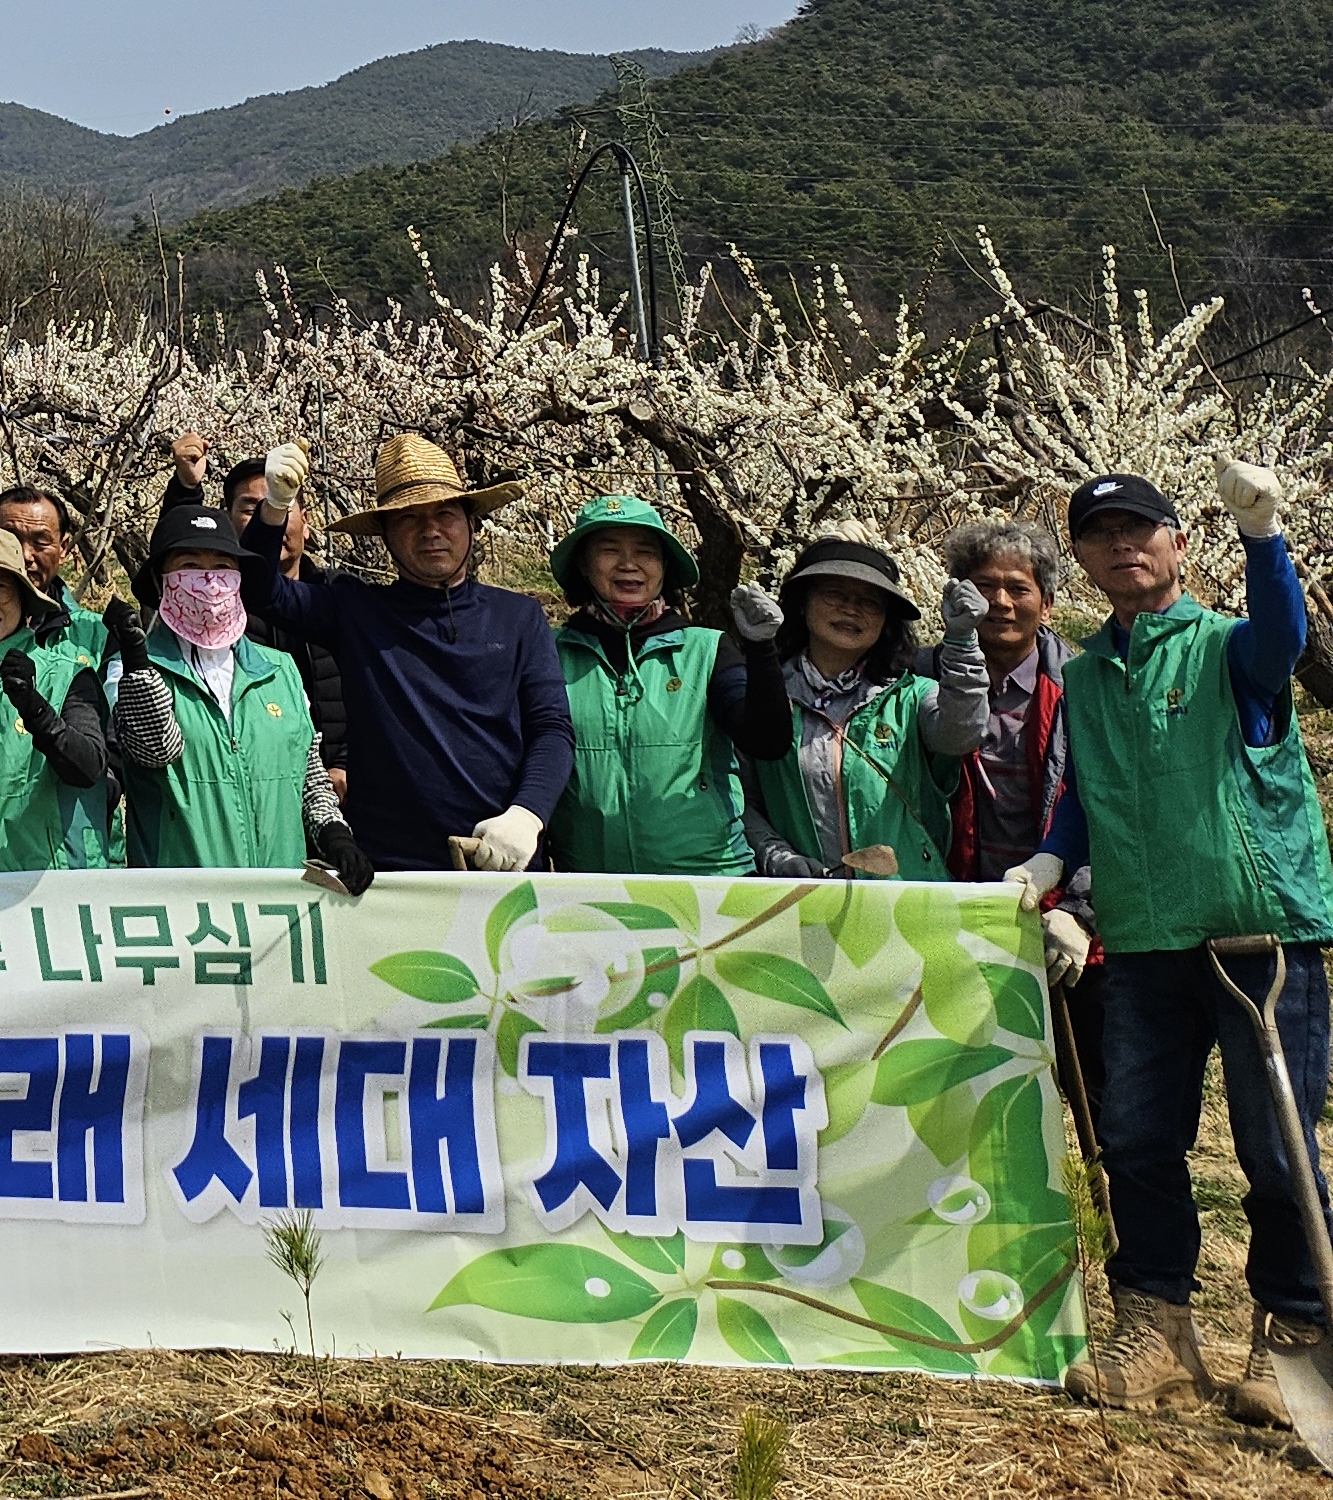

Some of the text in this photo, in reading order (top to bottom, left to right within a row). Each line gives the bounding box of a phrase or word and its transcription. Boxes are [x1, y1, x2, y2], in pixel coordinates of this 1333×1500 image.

[34, 903, 326, 985] 나무심기
[174, 1038, 484, 1213] 세대
[529, 1042, 805, 1225] 자산
